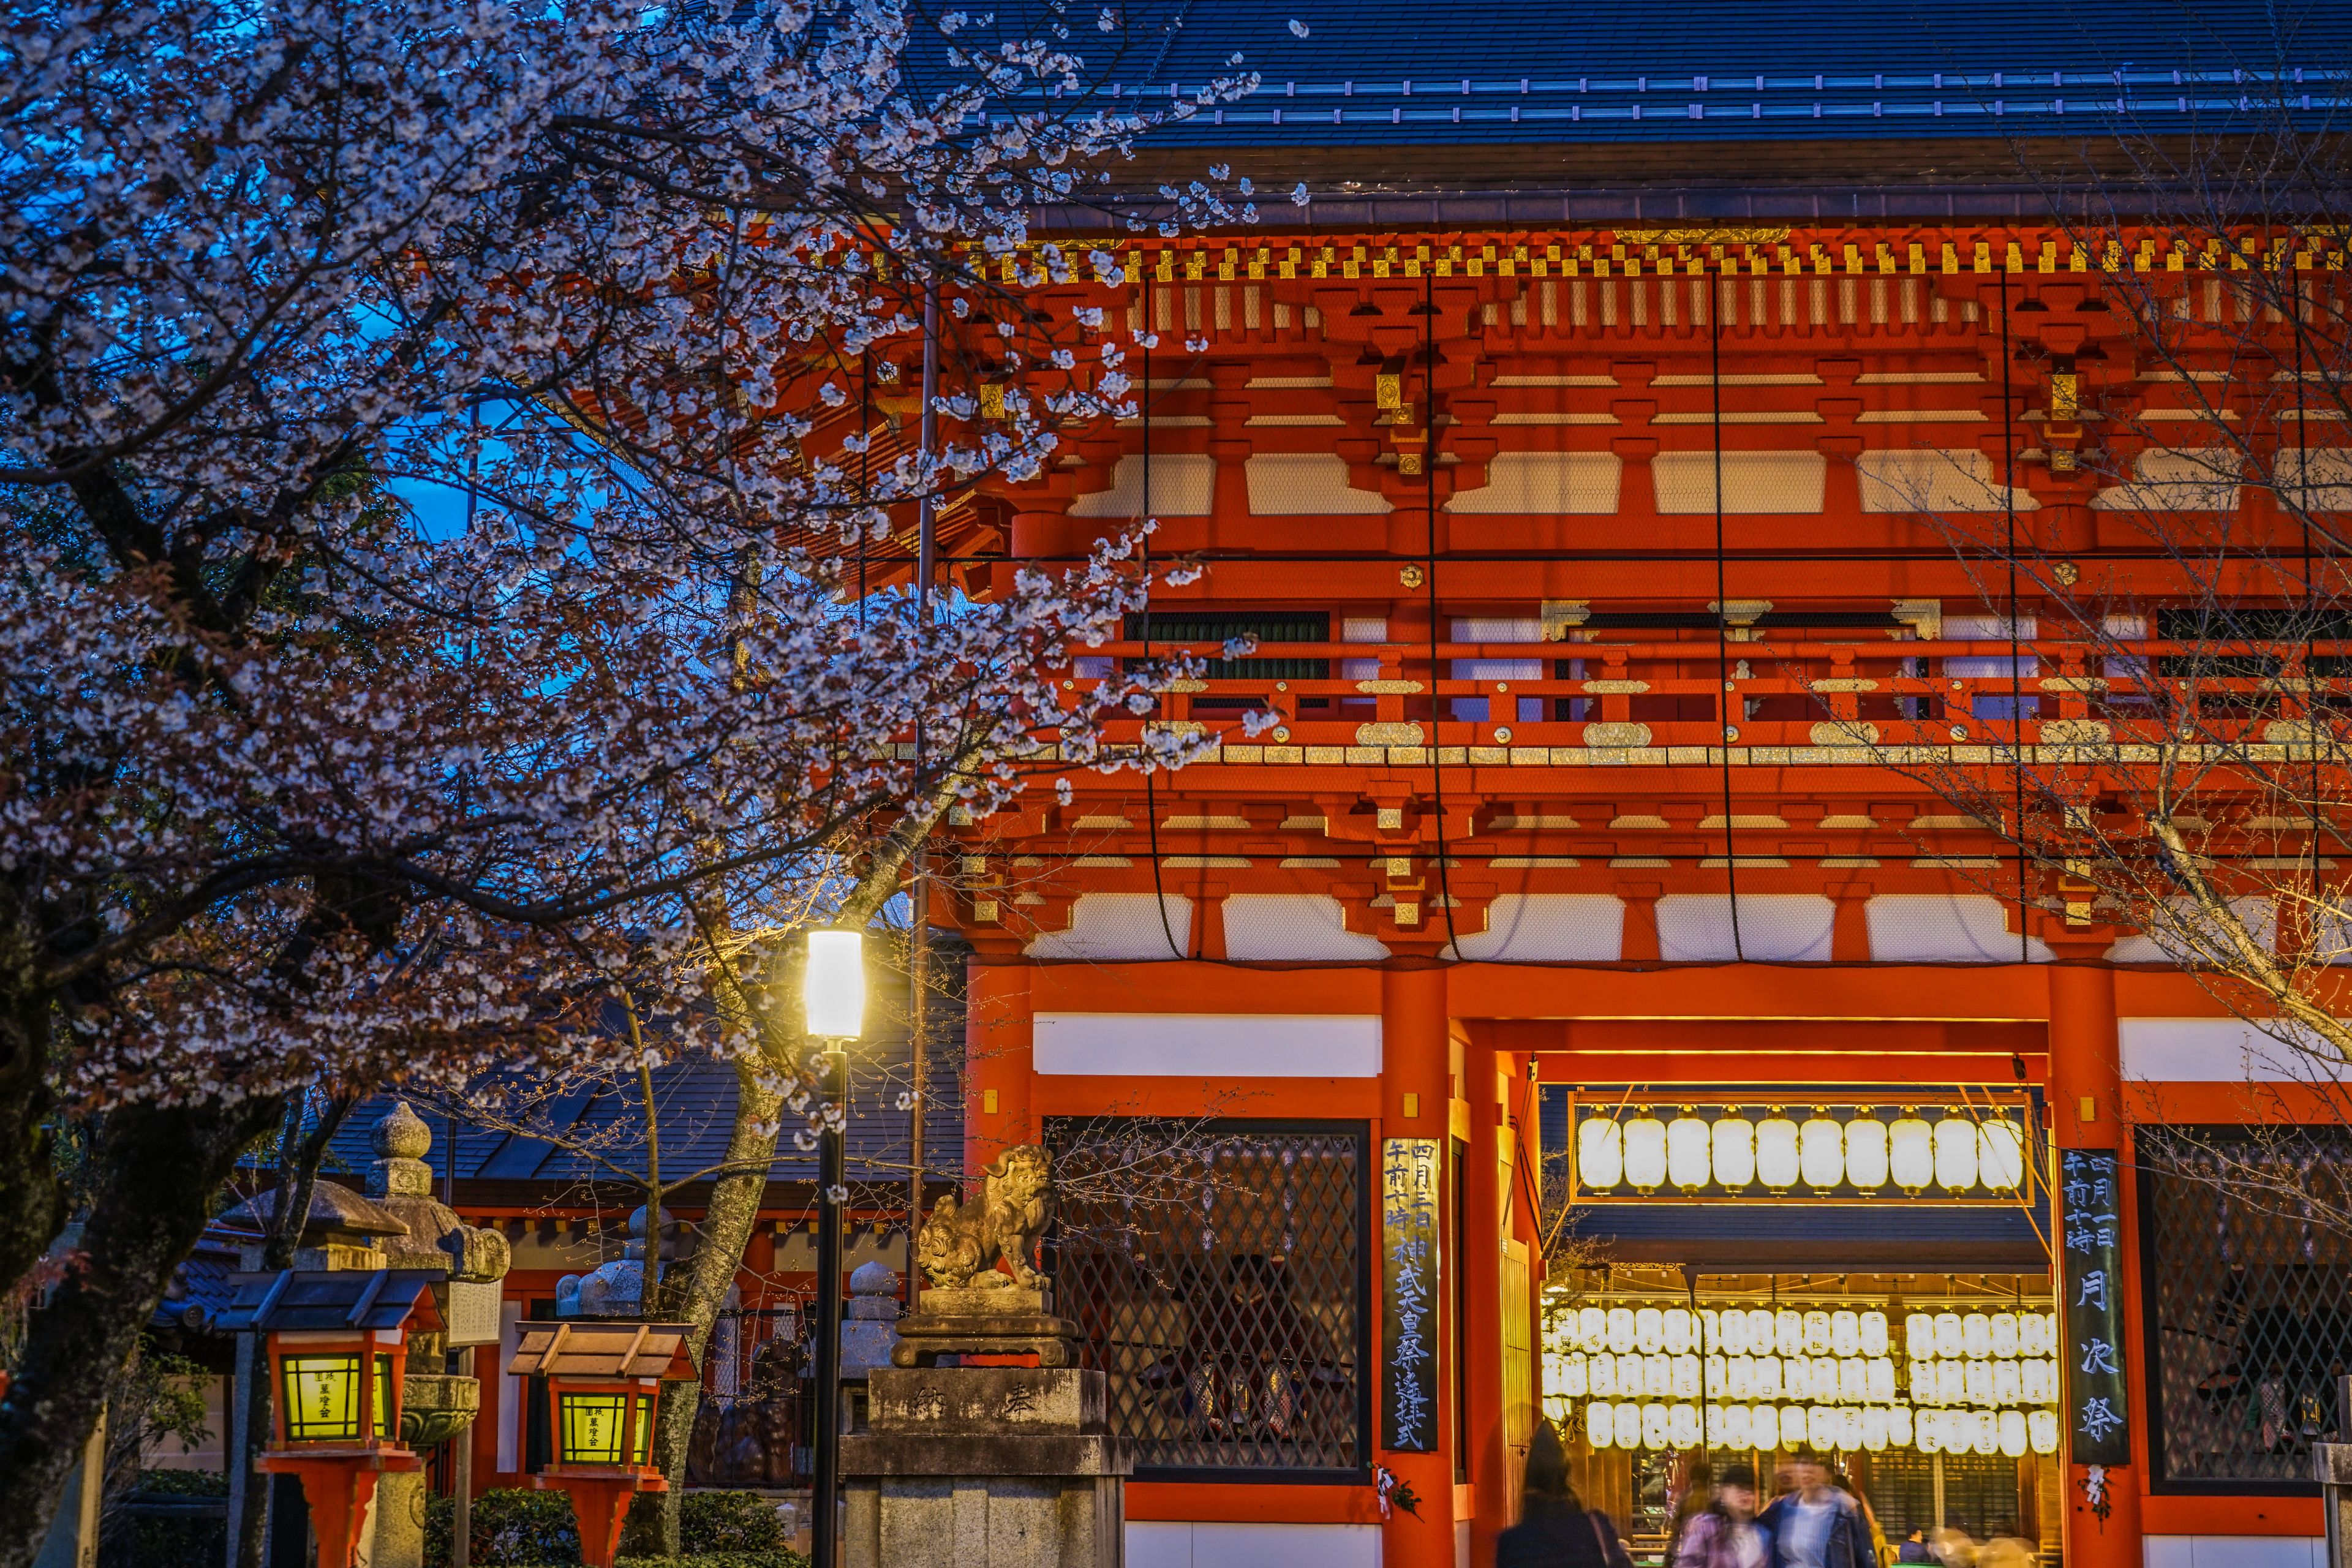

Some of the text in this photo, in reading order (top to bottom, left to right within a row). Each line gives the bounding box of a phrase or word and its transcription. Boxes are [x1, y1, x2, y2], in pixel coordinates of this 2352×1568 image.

[1384, 1140, 1411, 1231] 午前十時
[1411, 1145, 1435, 1229] 四月三日
[2062, 1152, 2095, 1254] 午前十時
[2089, 1156, 2117, 1247] 四月一日
[2076, 1270, 2123, 1443] 月次祭
